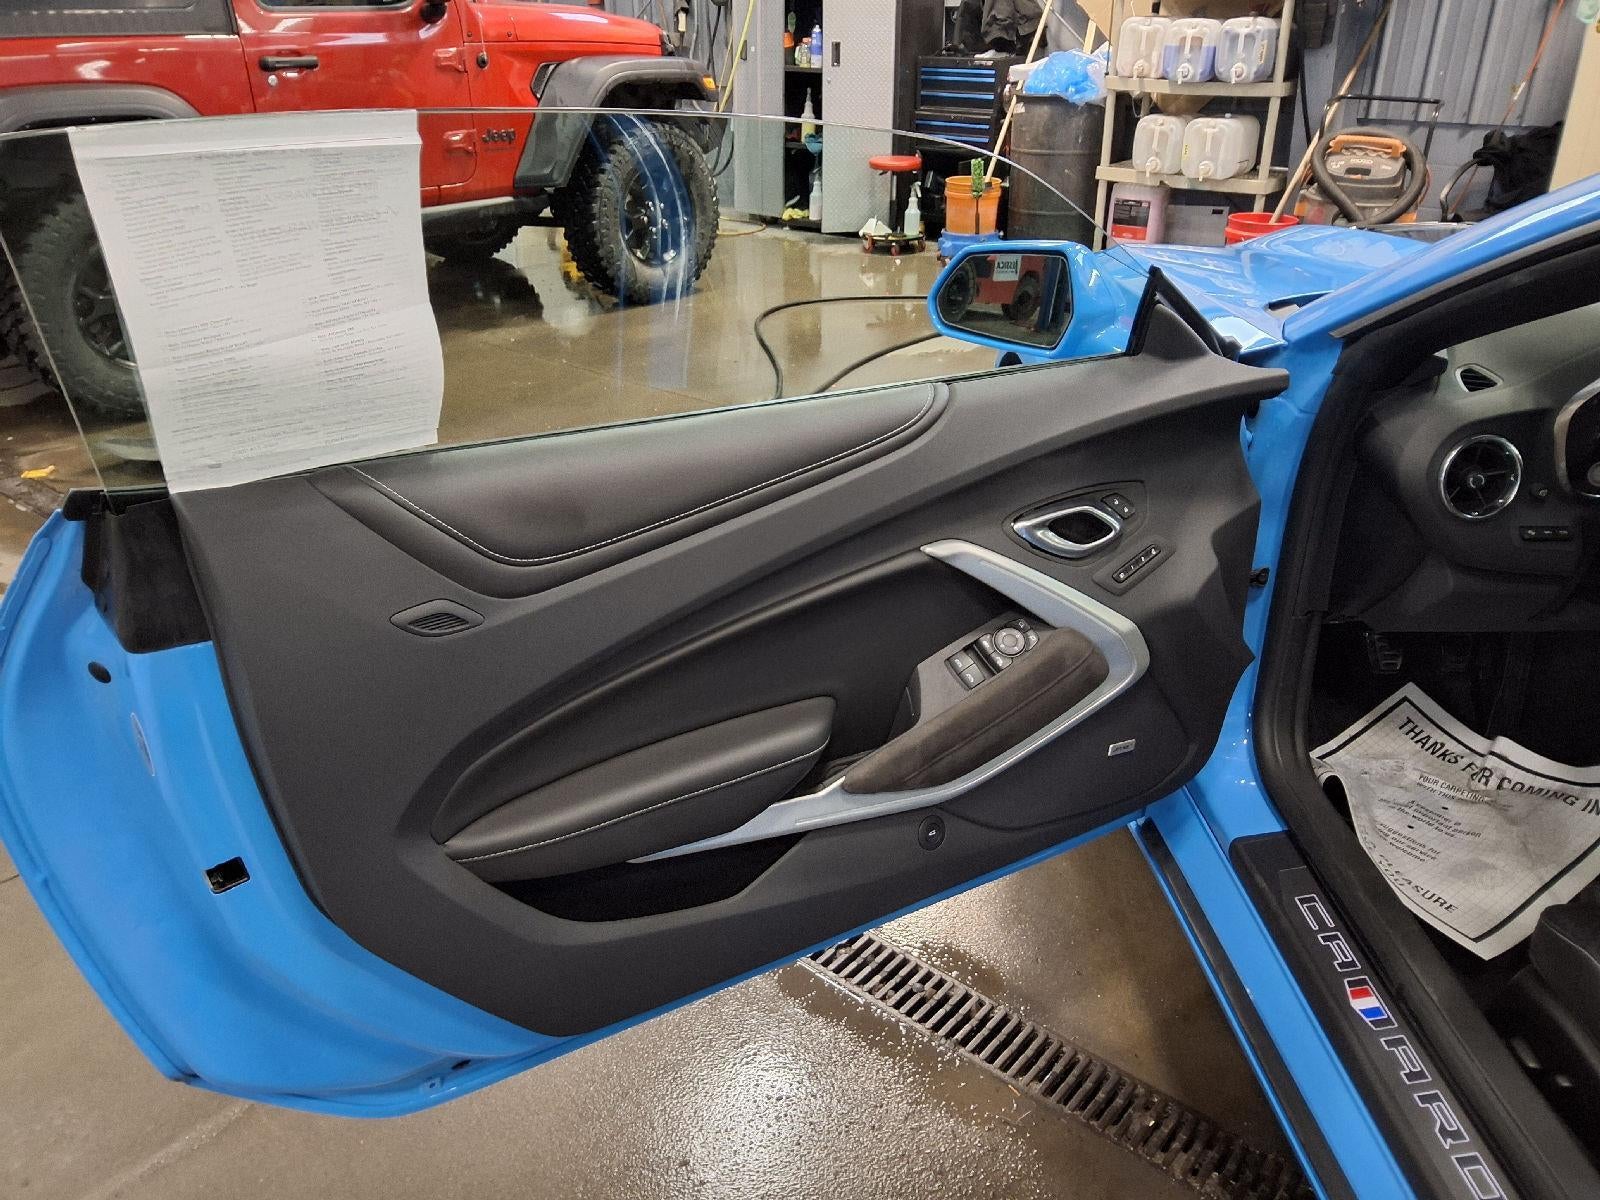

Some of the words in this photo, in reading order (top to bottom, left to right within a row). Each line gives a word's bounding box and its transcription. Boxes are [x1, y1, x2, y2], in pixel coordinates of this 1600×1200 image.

[482, 128, 516, 144] Jeep
[1398, 717, 1464, 765] THANKS
[1496, 776, 1579, 807] COMING
[1419, 775, 1440, 787] YOUR
[1412, 814, 1435, 828] world
[1295, 893, 1508, 1200] CAARO
